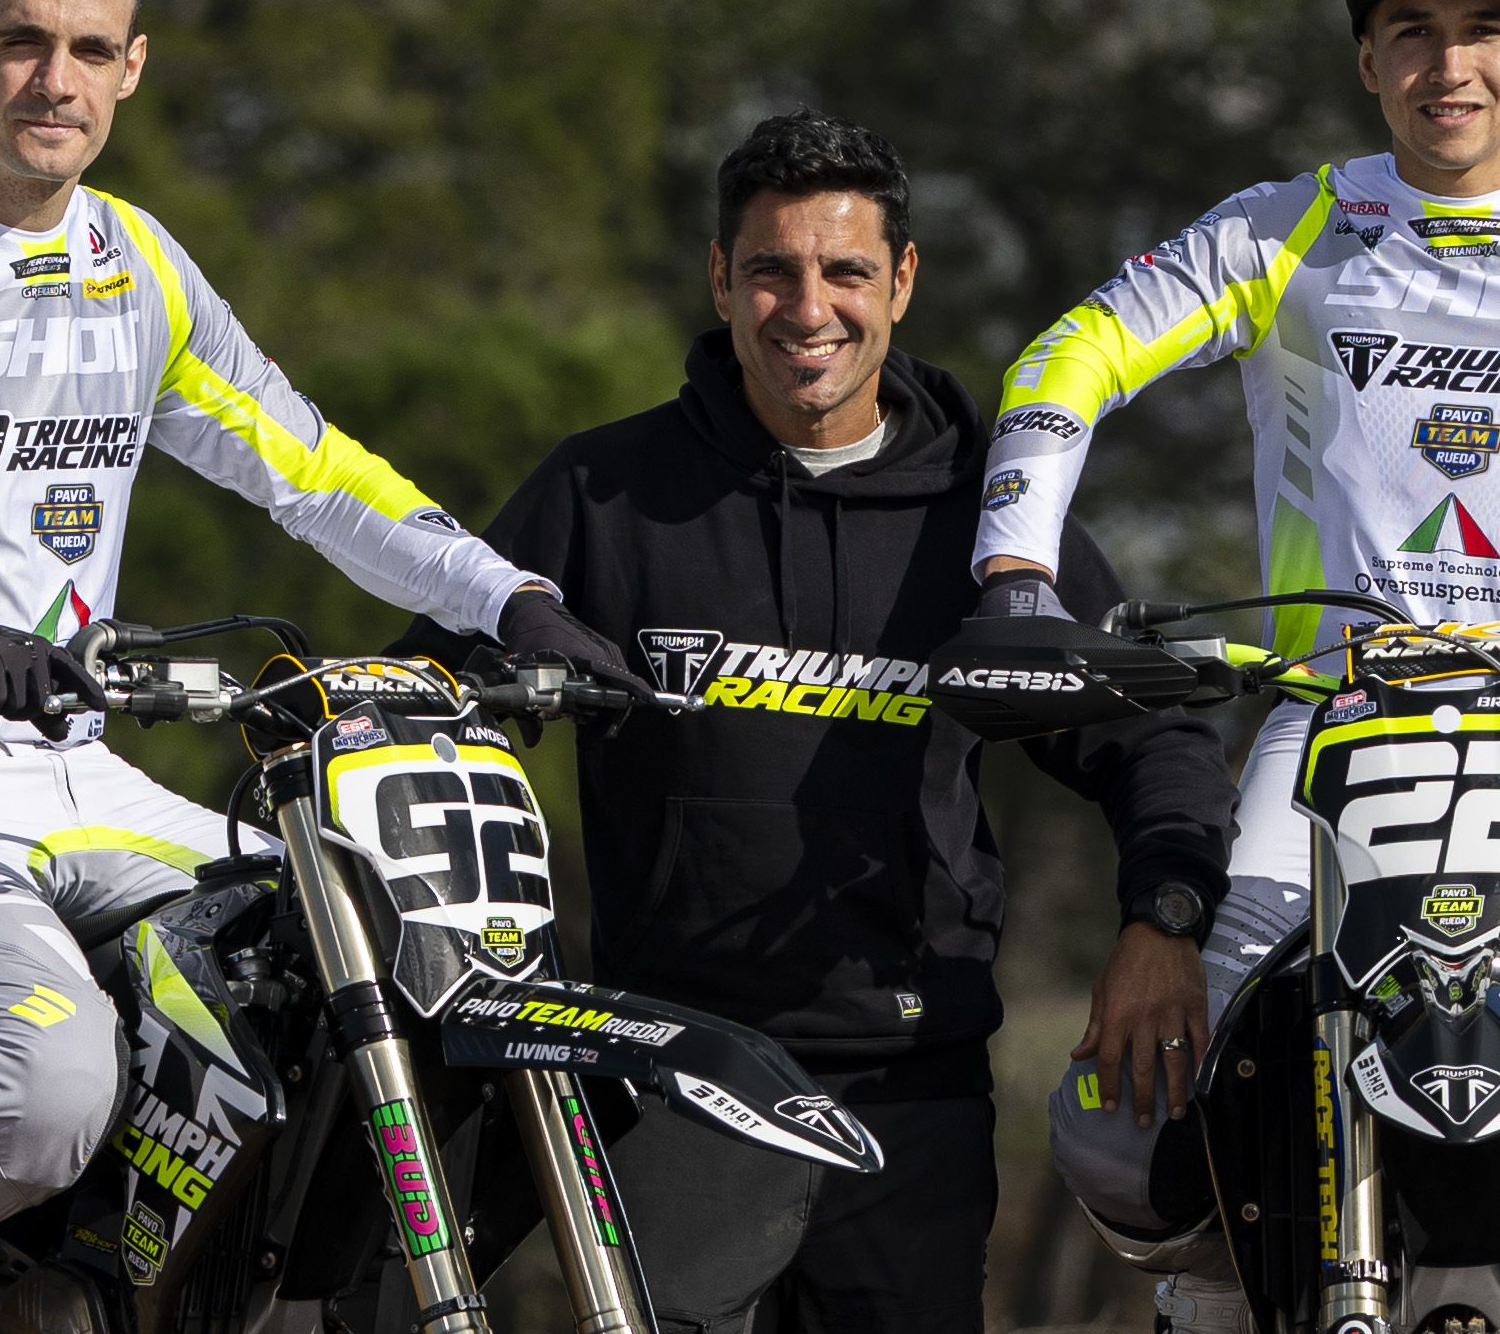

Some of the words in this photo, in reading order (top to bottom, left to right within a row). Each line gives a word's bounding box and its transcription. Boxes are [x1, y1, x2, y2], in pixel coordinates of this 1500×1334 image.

[1341, 335, 1385, 345] TRIUMPH
[1441, 410, 1482, 423] PAVO
[13, 414, 140, 447] TRIUMPH
[1427, 427, 1490, 445] TEAM
[5, 443, 137, 472] RACING
[1436, 451, 1476, 465] RUEDA
[54, 489, 88, 503] PAVO
[43, 510, 94, 526] TEAM
[53, 535, 87, 548] RUEDA
[1371, 556, 1433, 572] Supreme
[651, 635, 704, 648] TRIUMPH
[938, 667, 1085, 692] ACERBIS
[704, 674, 932, 725] RACING
[465, 727, 510, 749] ANDER
[375, 771, 551, 913] 92
[1440, 889, 1467, 898] PAVO
[1432, 901, 1474, 912] TEAM
[491, 920, 512, 928] PAVO
[1439, 917, 1466, 926] RUEDA
[488, 932, 518, 943] TEAM
[457, 998, 521, 1017] PAVO
[515, 1001, 613, 1031] TEAM
[598, 1018, 667, 1042] RUEDA
[504, 1042, 570, 1062] LIVING
[1432, 1069, 1484, 1078] TRIUMPH
[1364, 1066, 1389, 1100] SHOT
[713, 1098, 762, 1129] SHOT
[137, 1211, 158, 1234] PAVO
[126, 1226, 159, 1257] TEAM
[128, 1252, 149, 1273] RUEDA
